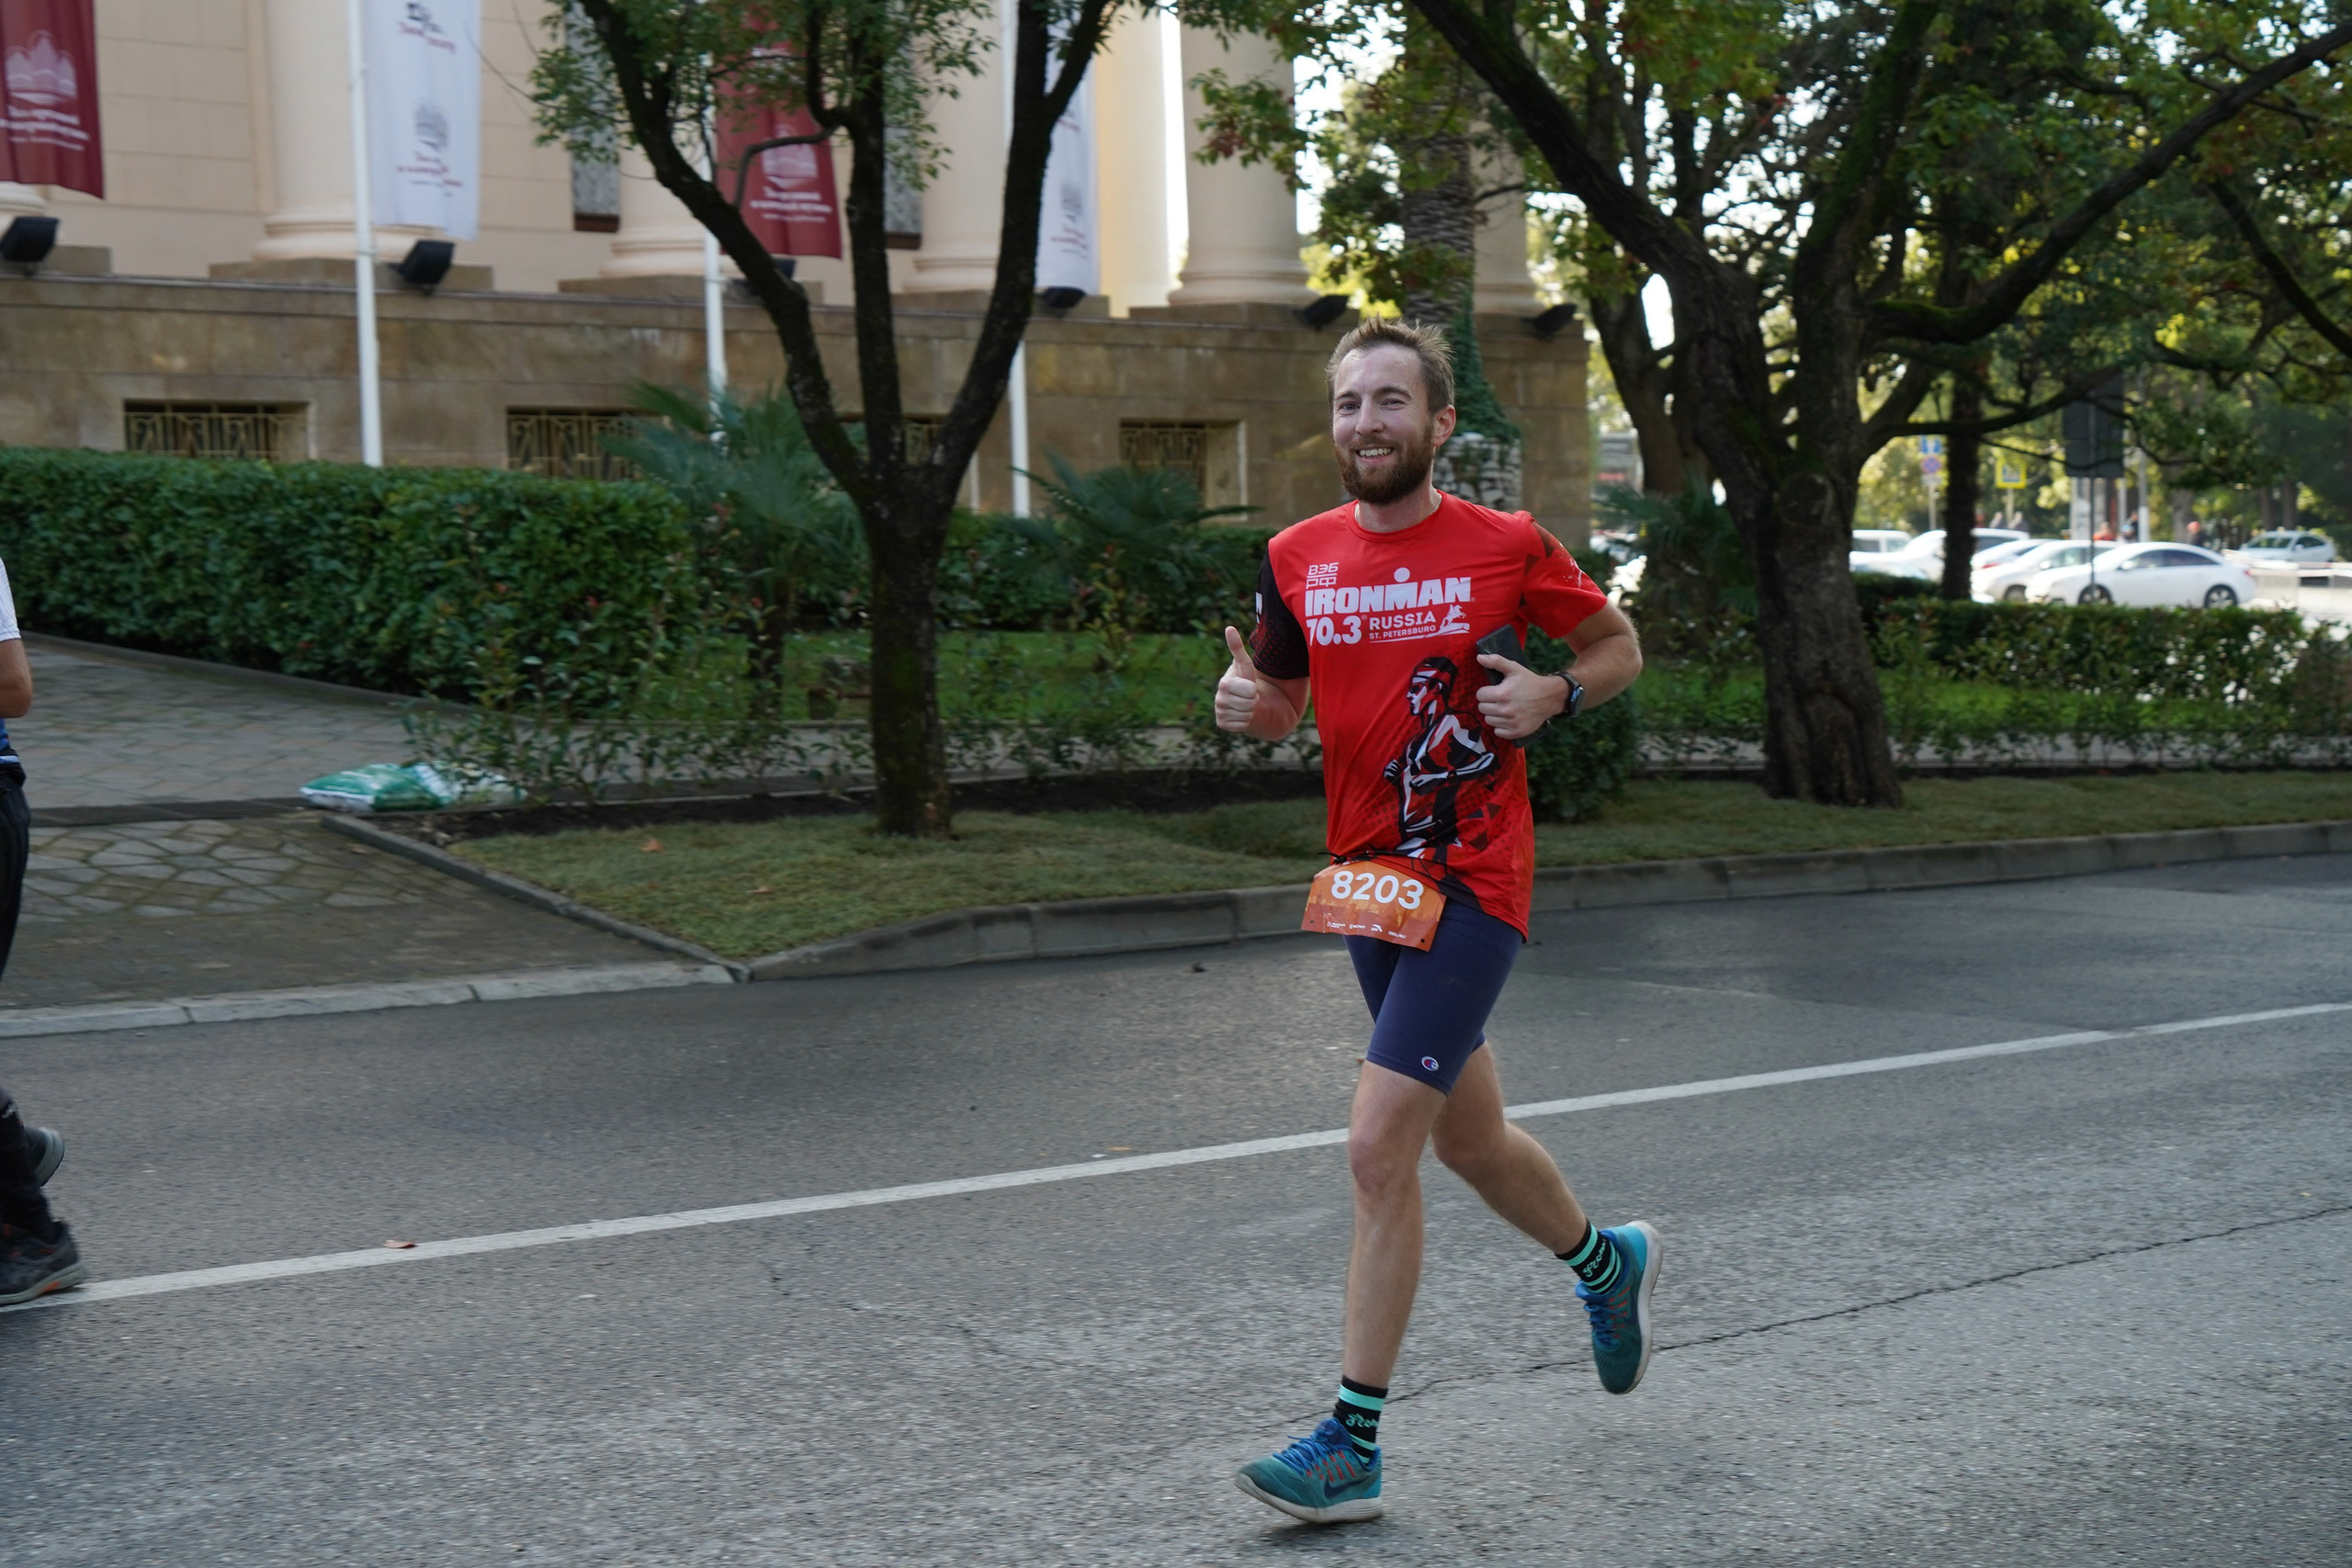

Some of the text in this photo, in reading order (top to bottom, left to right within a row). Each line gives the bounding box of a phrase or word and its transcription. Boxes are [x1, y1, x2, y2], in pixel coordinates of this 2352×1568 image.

[1308, 562, 1339, 575] ВЭБ
[1305, 568, 1471, 616] IRONMAN
[1306, 576, 1337, 589] РФ
[1306, 611, 1436, 646] 70.3 RUSSIA
[1369, 625, 1436, 639] ST. PETERSBURG
[1330, 870, 1424, 910] 8203
